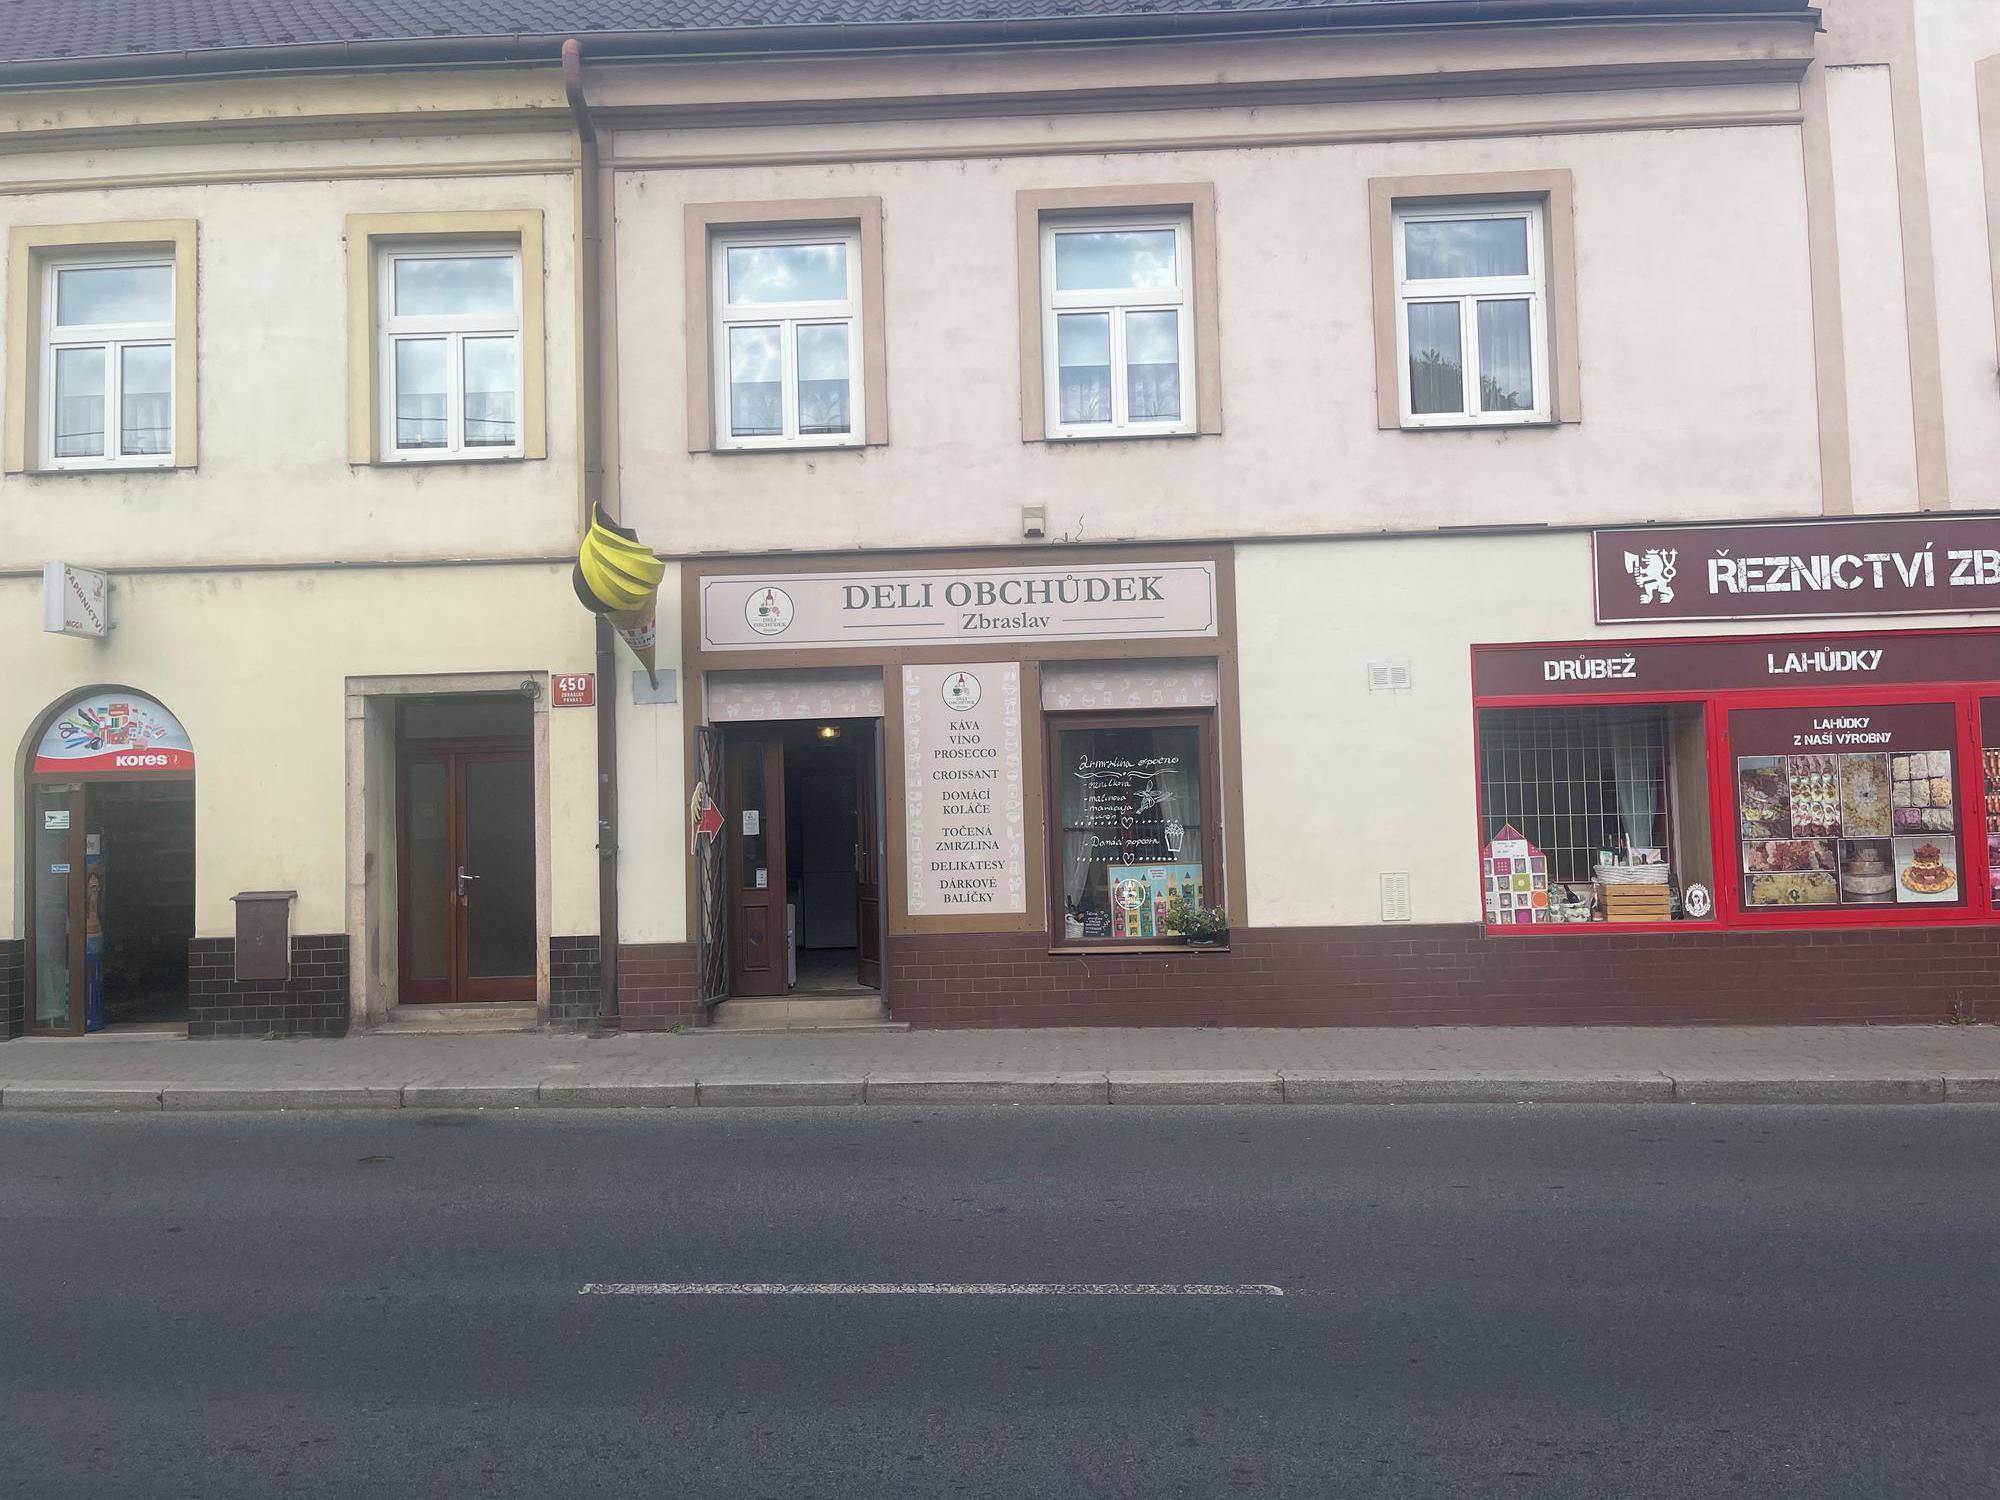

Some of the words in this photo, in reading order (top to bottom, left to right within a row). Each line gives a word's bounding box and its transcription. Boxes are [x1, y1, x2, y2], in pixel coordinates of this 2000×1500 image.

[1707, 542, 1935, 594] ŘEZNICTVÍ
[1947, 549, 2000, 586] ZB
[842, 583, 934, 610] DELI
[945, 574, 1165, 607] OBCHŮDEK
[962, 612, 1050, 630] Zbraslav
[1544, 652, 1637, 681] DRŮBEŽ
[1767, 647, 1883, 674] LAHŮDKY
[559, 677, 586, 691] 450
[949, 720, 980, 731] KÁVA
[1813, 715, 1870, 730] LAHŮDKY
[949, 732, 981, 744] VÍNO
[1793, 735, 1802, 746] Z
[1804, 731, 1833, 745] NAŠÍ
[1836, 730, 1892, 744] VÝROBNY
[934, 748, 997, 759] PROSECCO
[932, 769, 999, 780] CROISSANT
[942, 788, 990, 801] DOMÁCÍ
[943, 802, 991, 815] KOLÁČE
[942, 824, 993, 837] TOČENÁ
[935, 841, 1000, 851] ZMRZLINA
[931, 860, 1006, 871] DELIKATESY
[940, 876, 998, 889] DÁRKOVÉ
[944, 890, 995, 904] BALÍČKY
